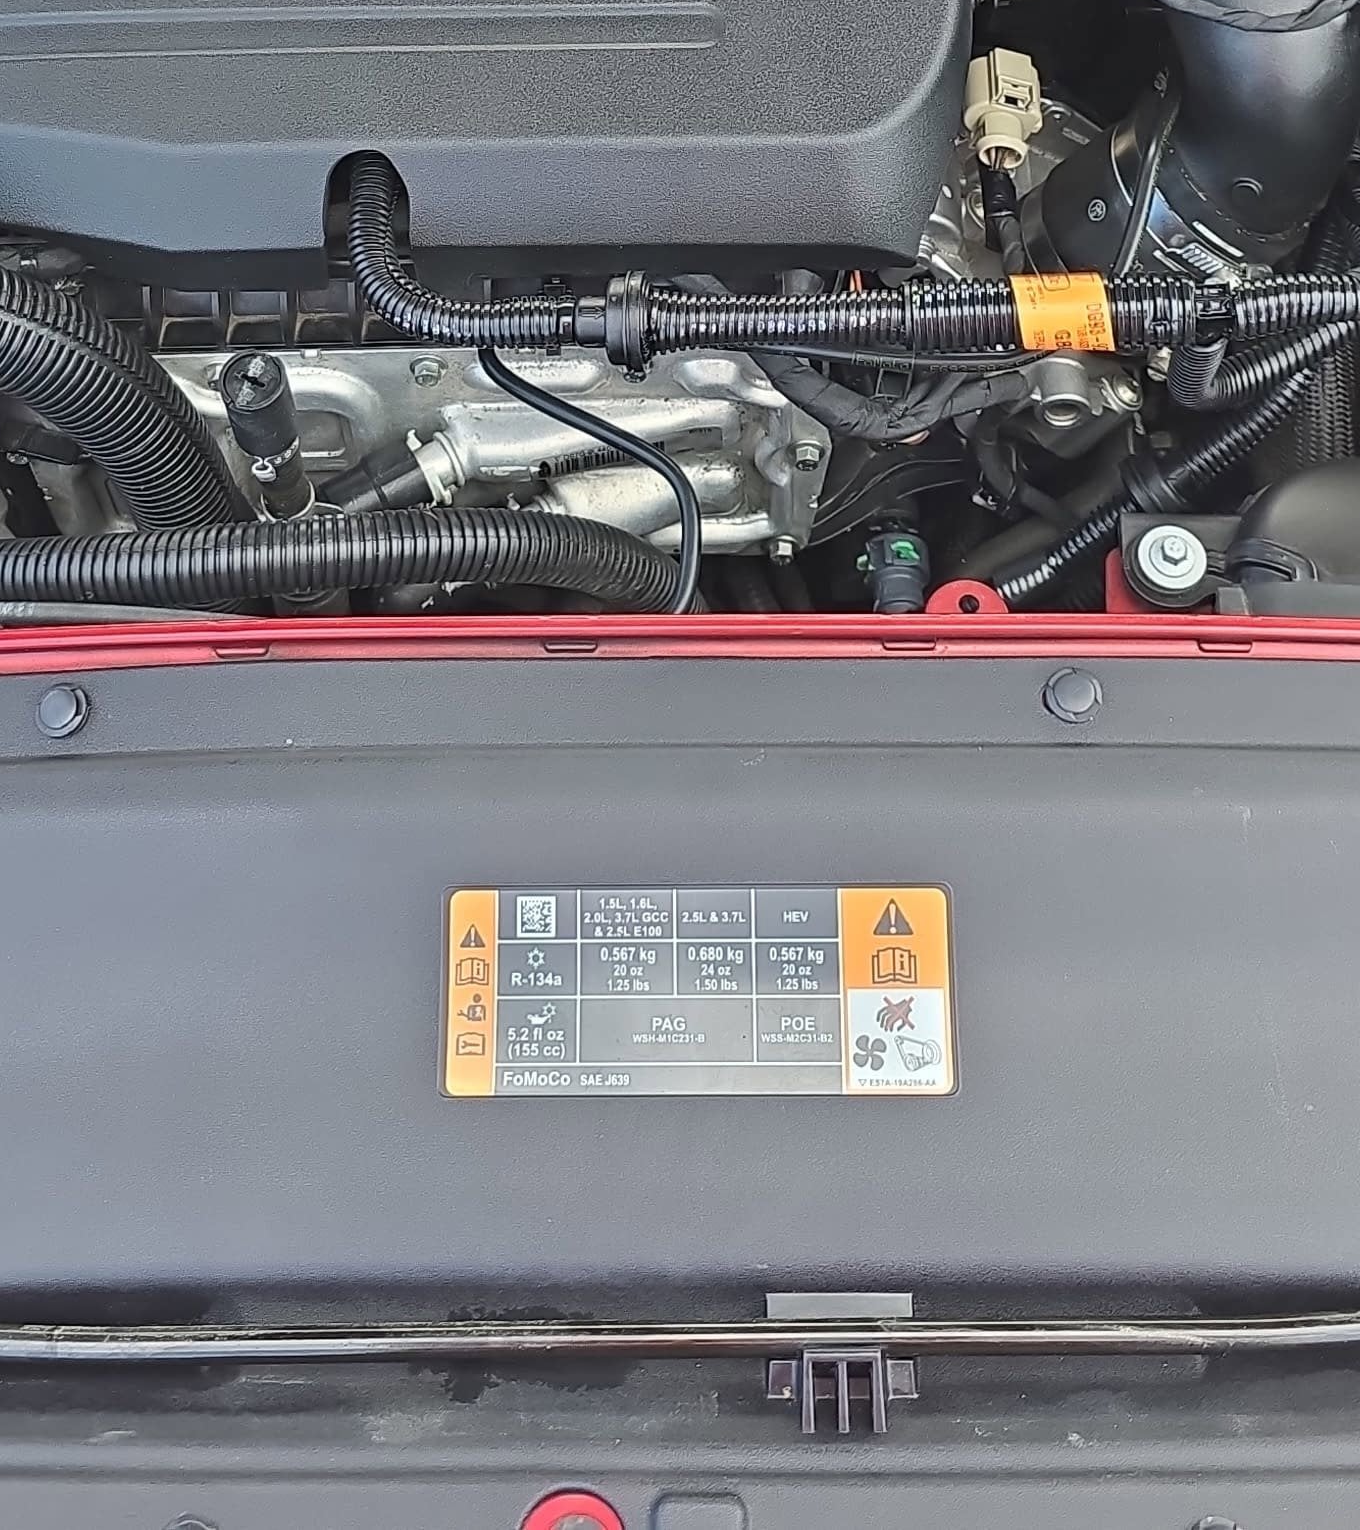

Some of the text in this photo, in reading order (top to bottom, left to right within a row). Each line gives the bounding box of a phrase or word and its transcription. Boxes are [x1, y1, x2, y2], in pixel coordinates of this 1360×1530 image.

[599, 898, 657, 910] 1.5L, 1.6L,
[584, 913, 668, 924] 2.0L, 3.7L GCC
[681, 912, 746, 923] 2.5L & 3.7L
[783, 911, 809, 922] HEV
[594, 926, 662, 937] & 2.5L E100
[600, 947, 656, 964] 0.567 kg
[688, 946, 744, 964] 0.680 kg
[769, 946, 824, 964] 0.567 kg
[613, 965, 643, 976] 20 oz
[701, 964, 731, 976] 24 oz
[782, 964, 812, 975] 20 oz
[511, 972, 562, 987] R-134a
[607, 979, 650, 991] 1.25 lbs
[694, 979, 738, 990] 1.50 lbs
[776, 978, 818, 990] 1.25 lbs
[652, 1017, 687, 1031] PAG
[781, 1017, 816, 1031] POE
[507, 1027, 564, 1041] 5.2 fl oz
[761, 1033, 834, 1043] WSS-M2C31-B2
[508, 1043, 566, 1060] (155 cc)
[503, 1071, 630, 1086] FoMoCo SAE J639
